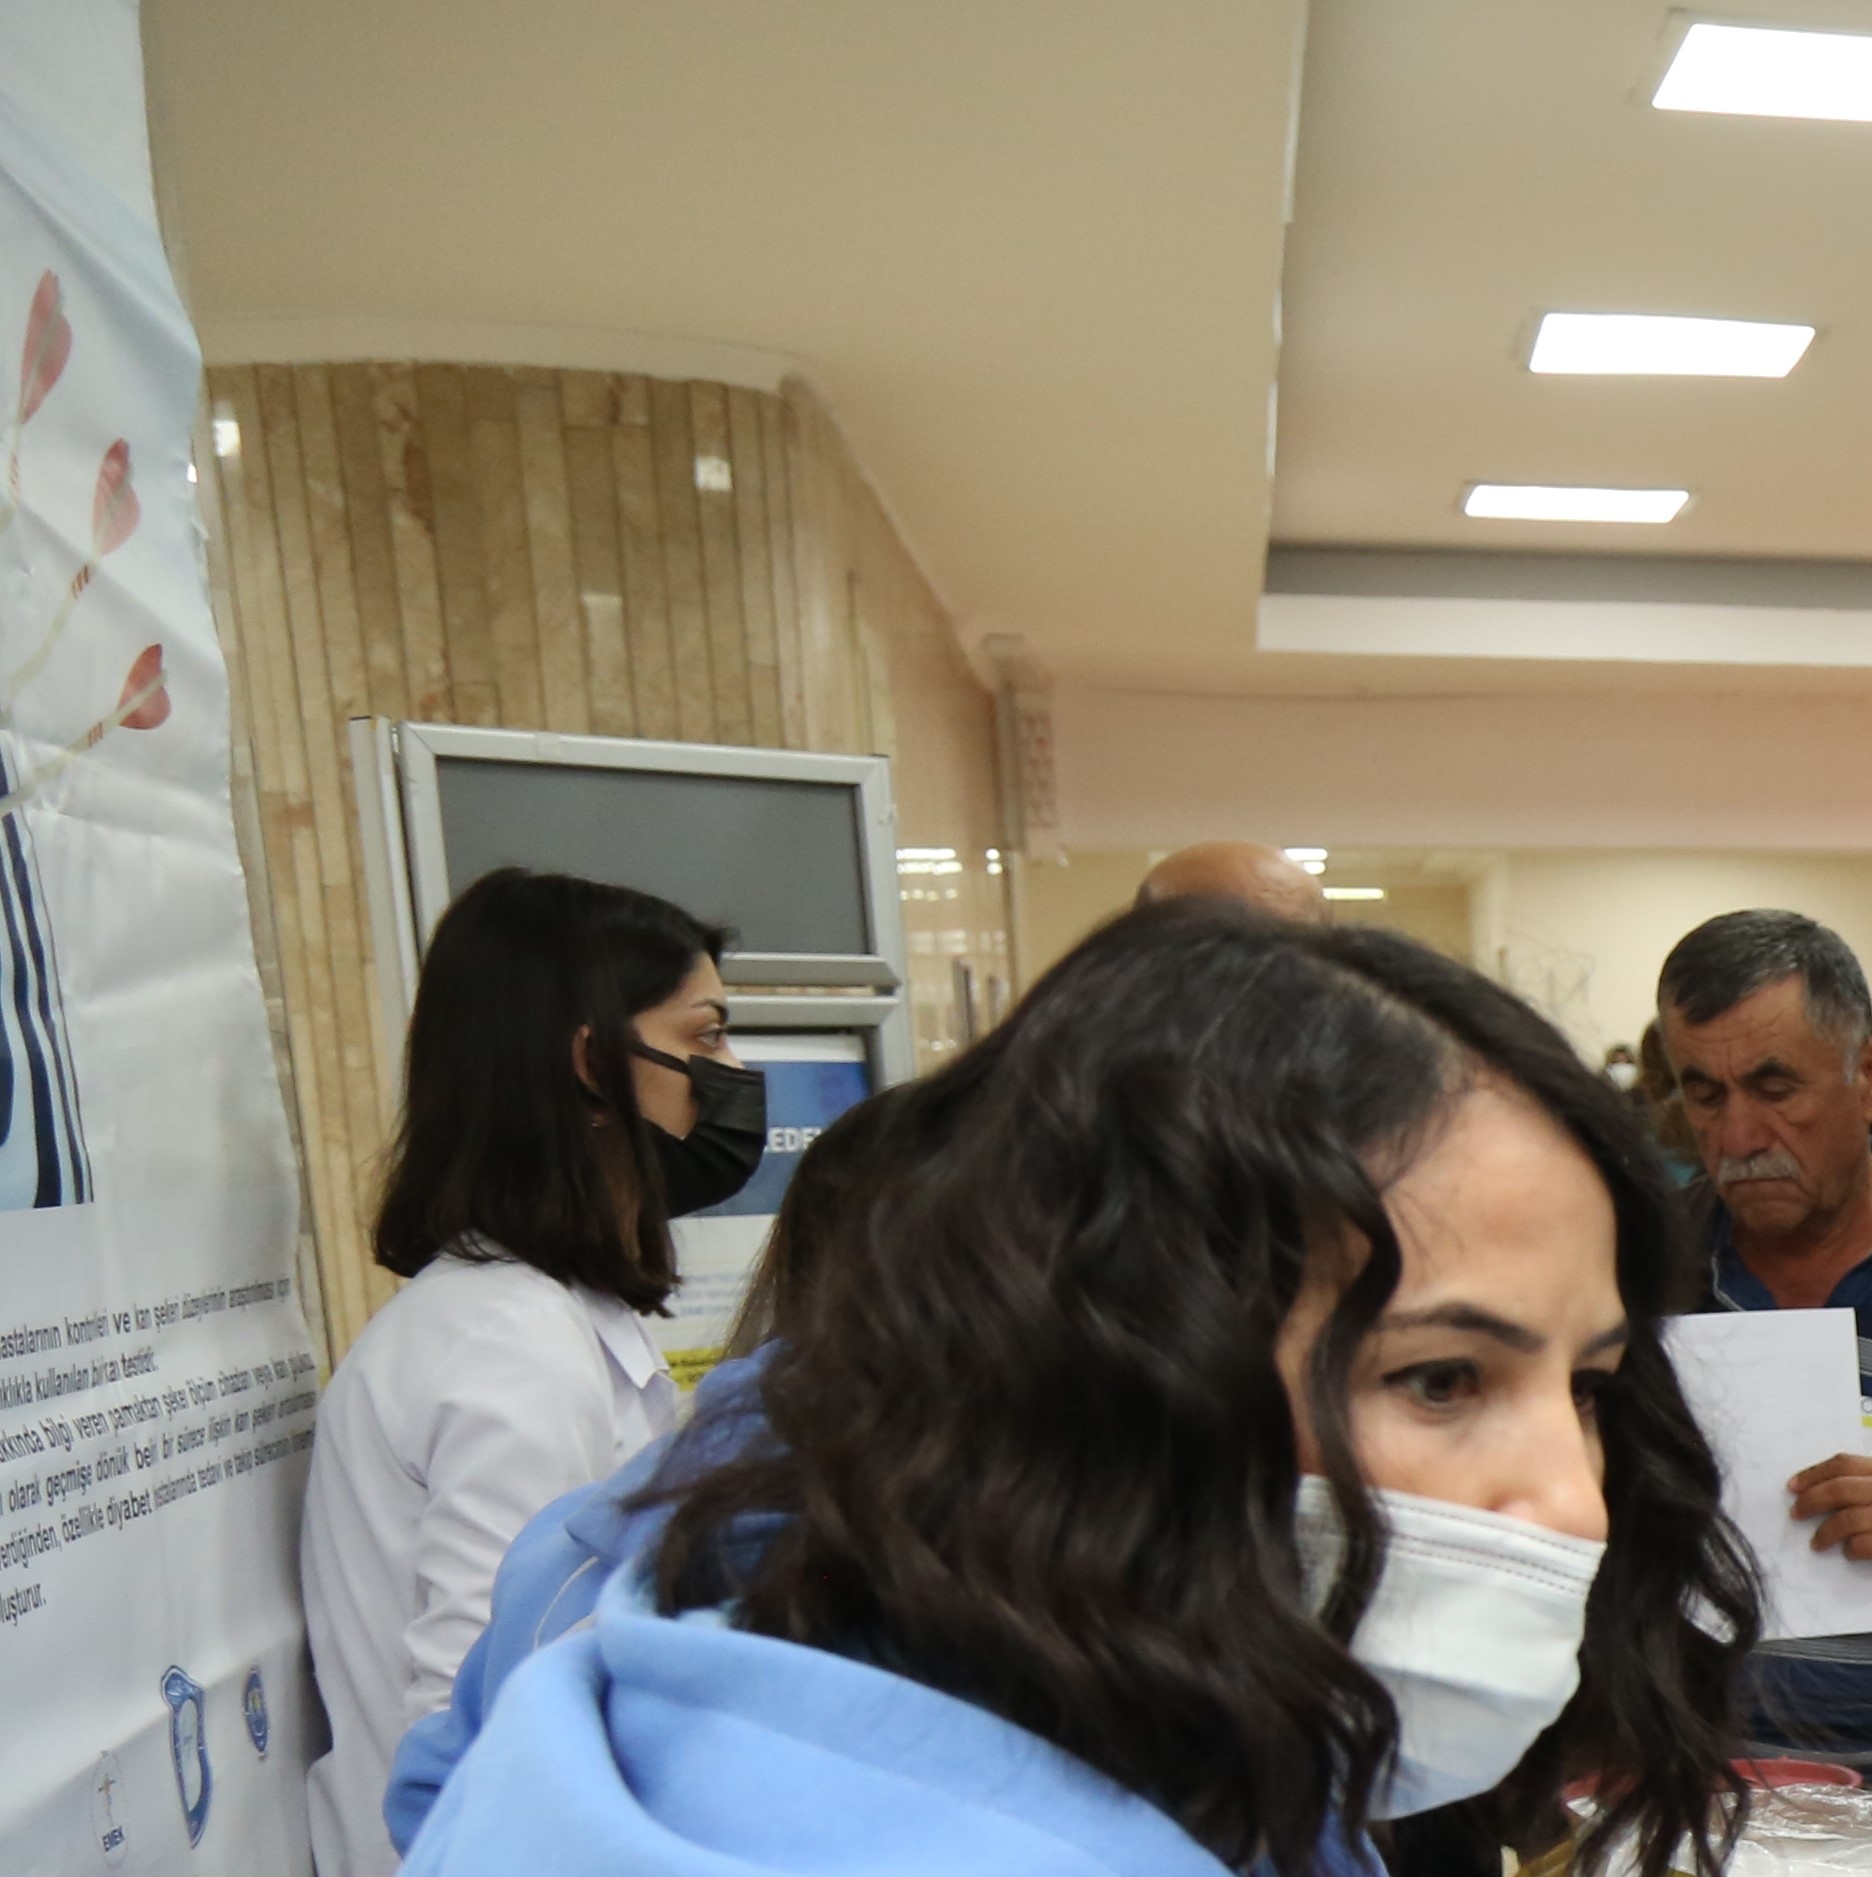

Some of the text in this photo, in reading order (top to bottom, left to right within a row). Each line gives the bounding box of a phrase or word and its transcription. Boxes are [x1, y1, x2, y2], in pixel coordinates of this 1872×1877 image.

[113, 1311, 132, 1335] ve
[0, 1524, 63, 1571] erdiğinden,
[106, 1488, 154, 1532] diyabet
[103, 1824, 126, 1857] EMEK
